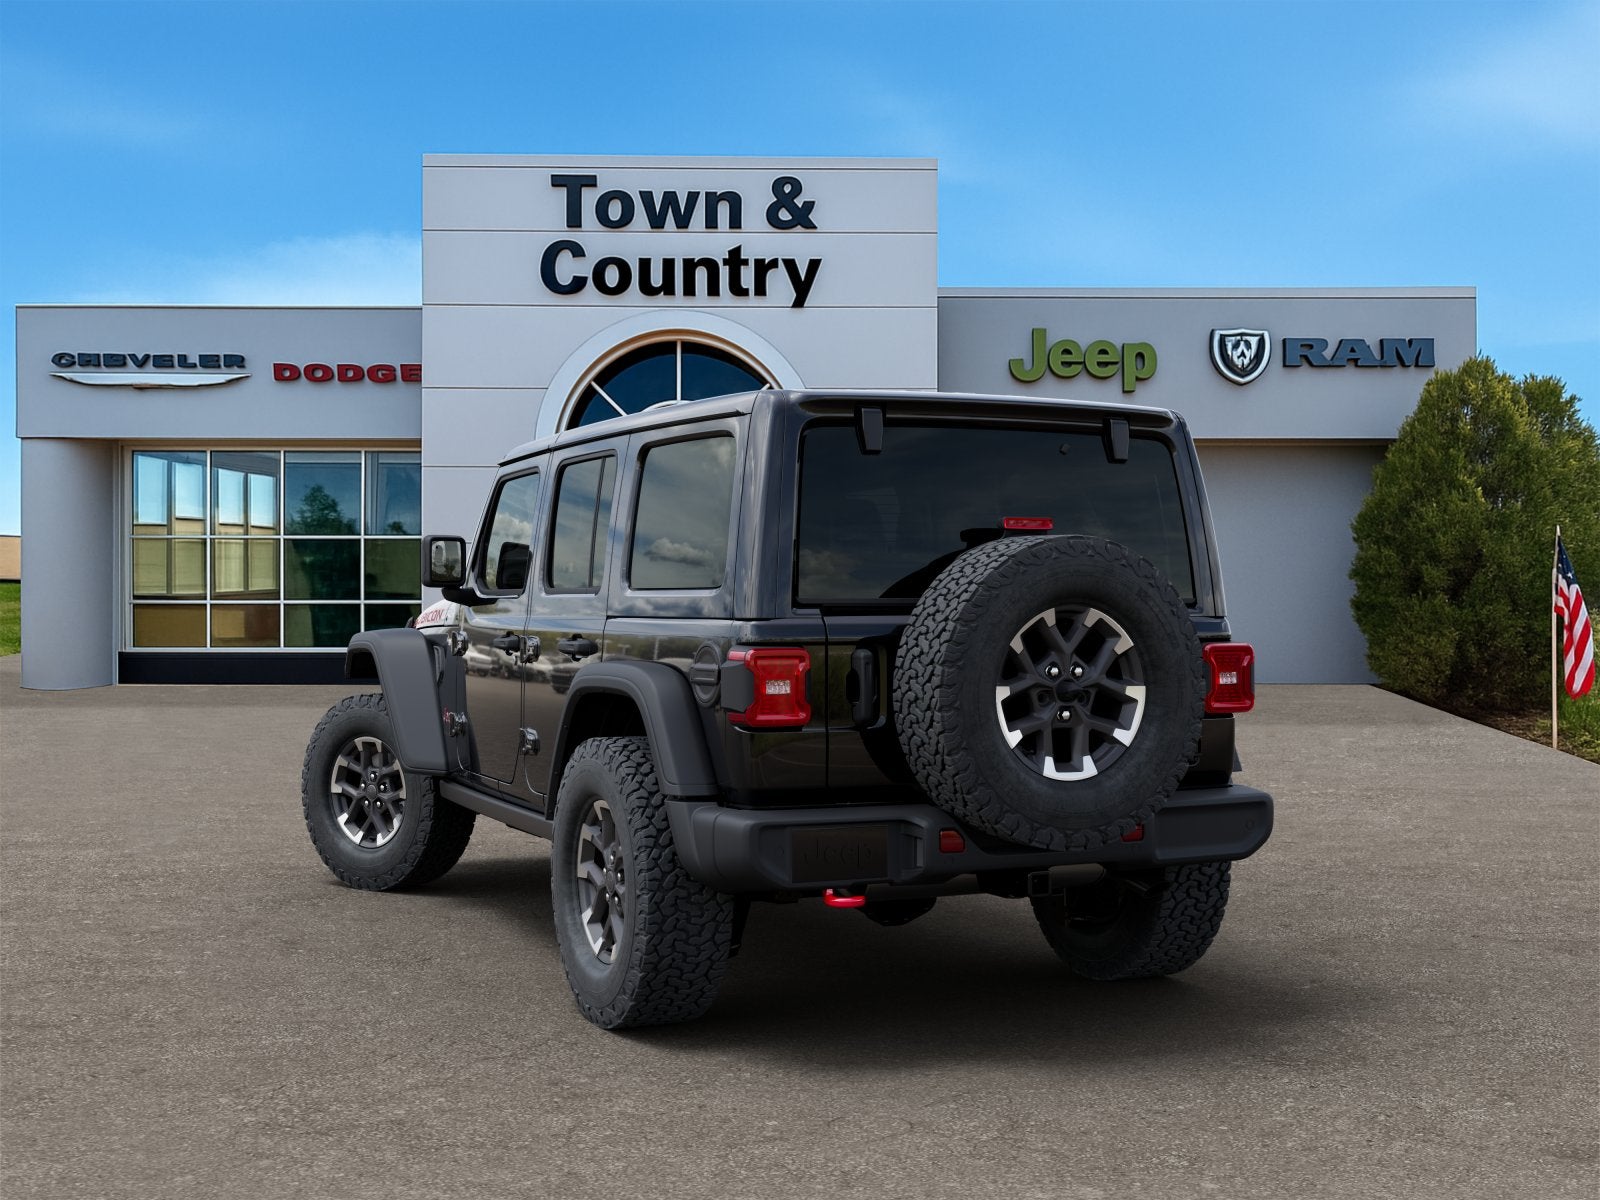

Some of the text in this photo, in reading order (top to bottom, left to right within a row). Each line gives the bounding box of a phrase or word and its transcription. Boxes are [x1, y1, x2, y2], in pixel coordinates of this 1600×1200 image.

[550, 173, 818, 230] Town &
[539, 239, 823, 309] Country
[272, 362, 422, 384] DODGE
[1008, 327, 1158, 393] Jeep
[1282, 337, 1435, 368] RAM
